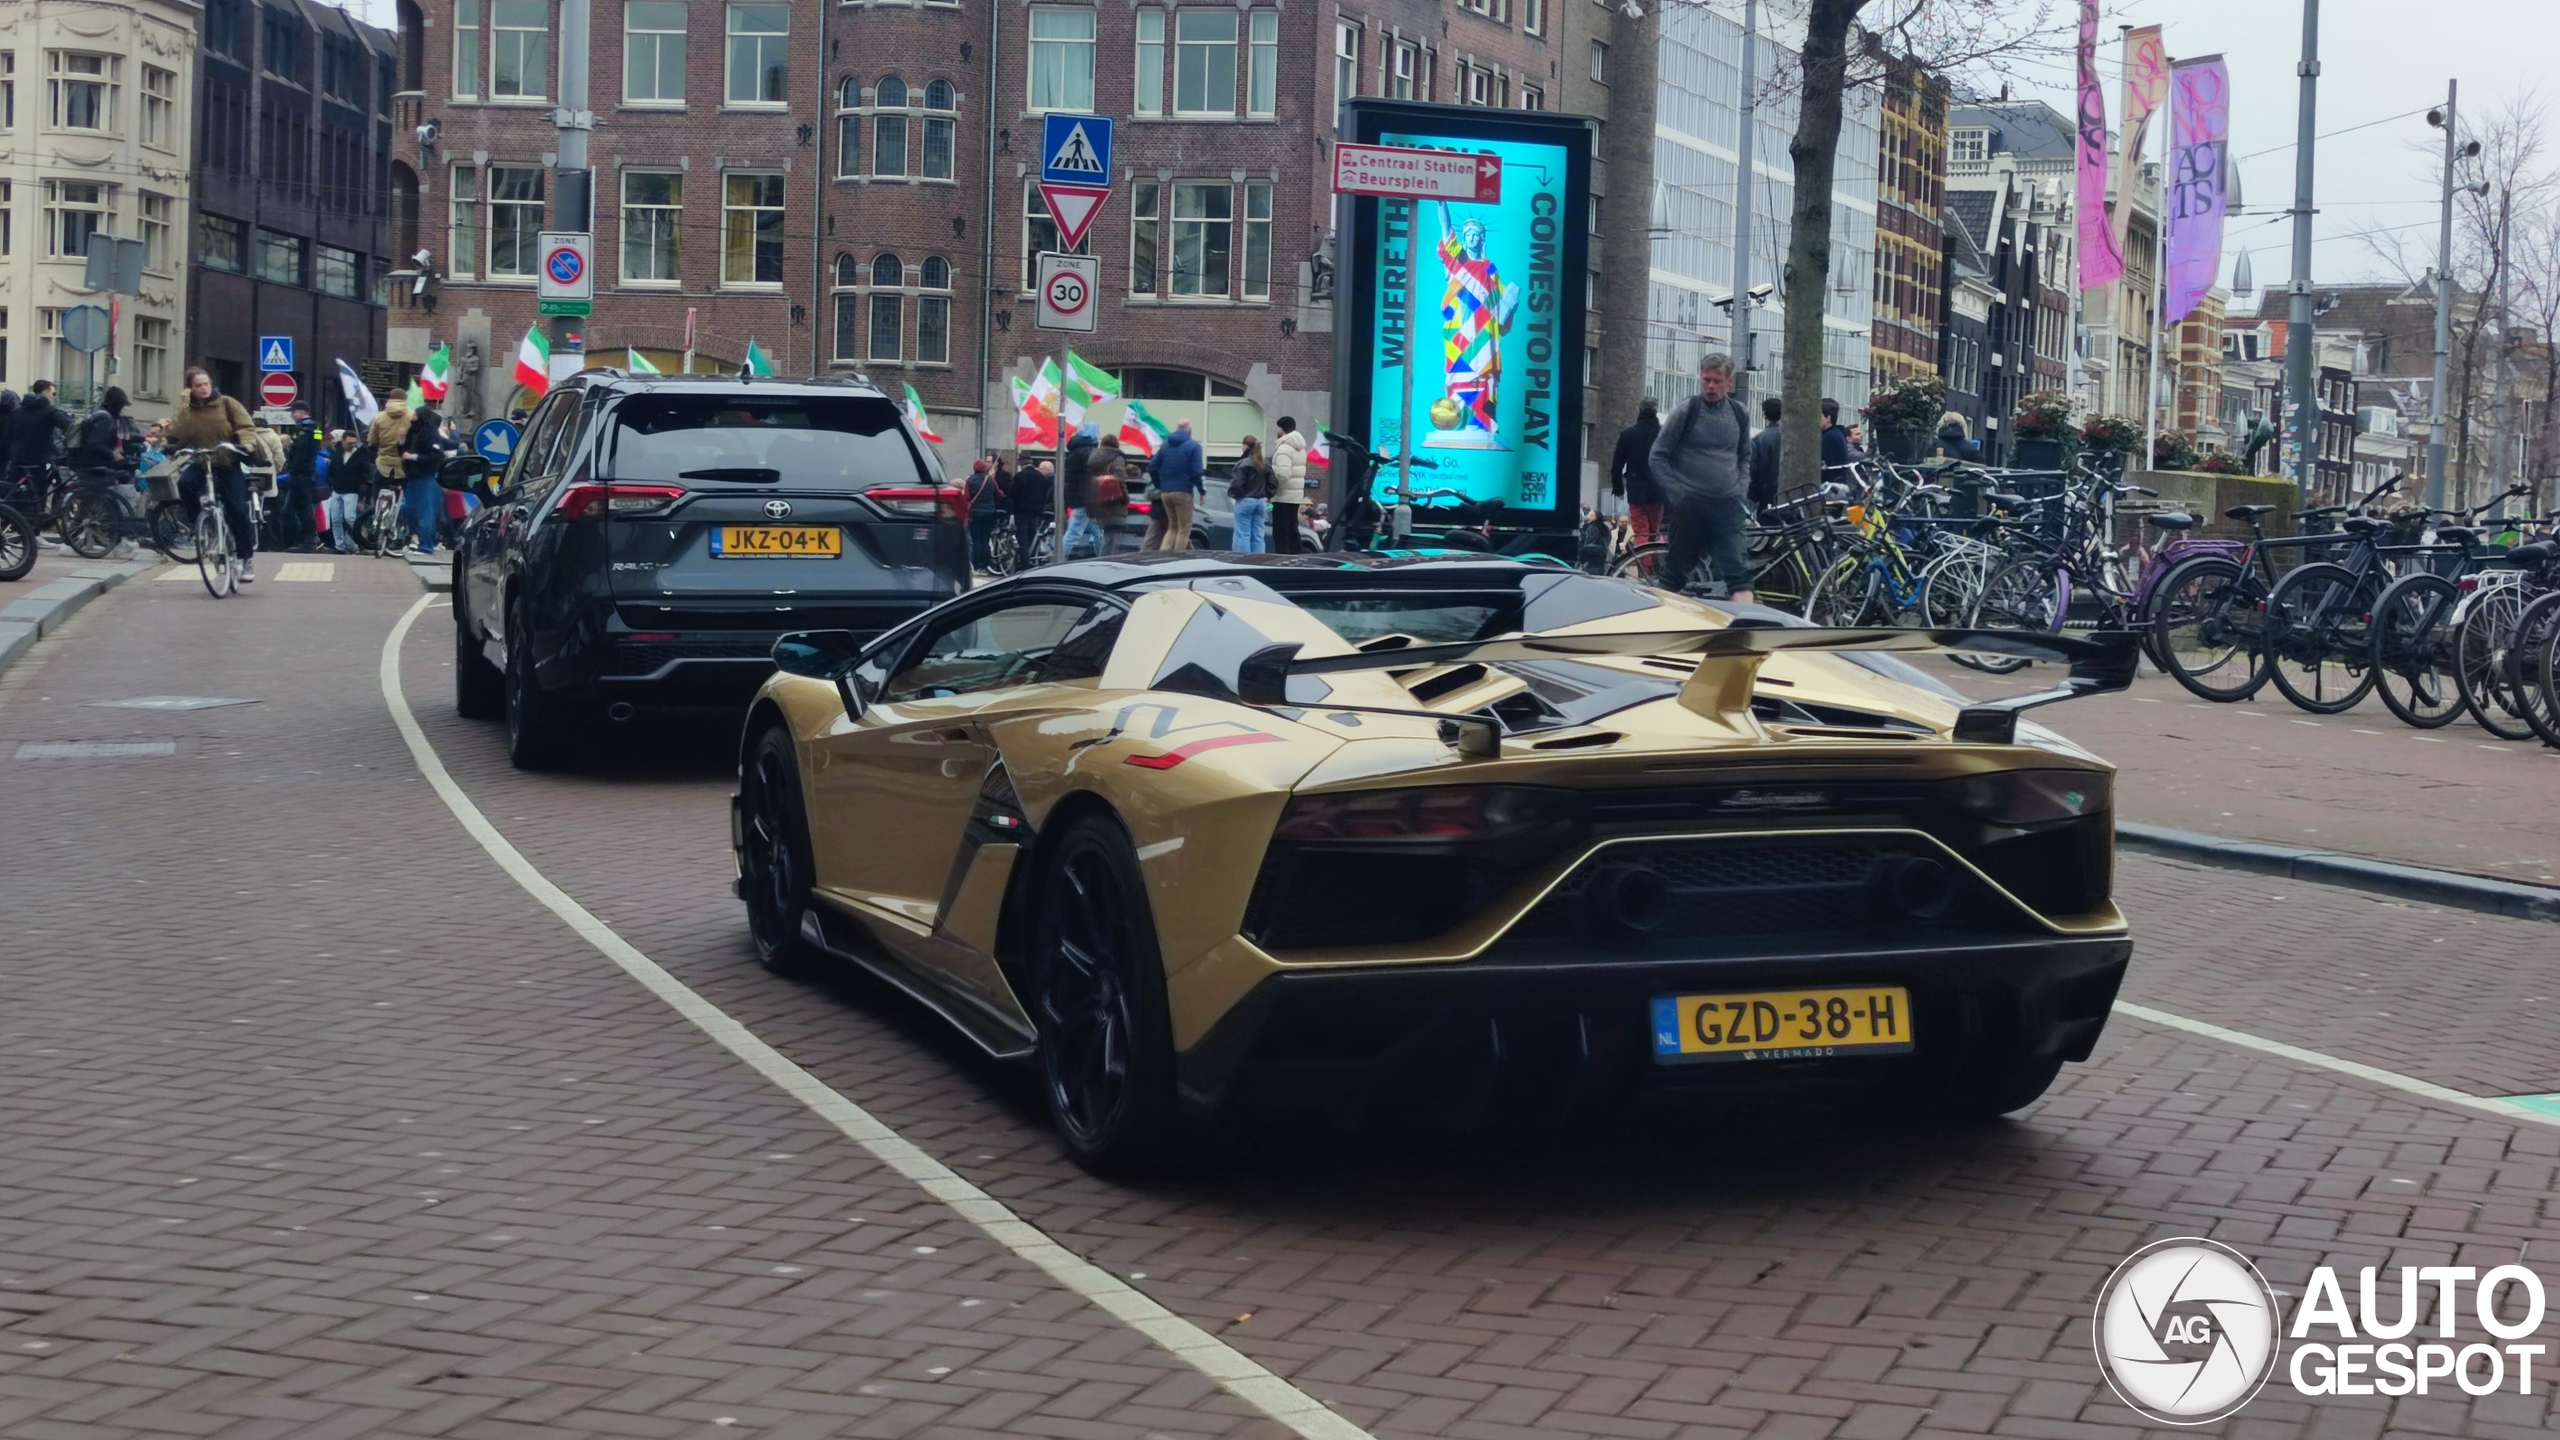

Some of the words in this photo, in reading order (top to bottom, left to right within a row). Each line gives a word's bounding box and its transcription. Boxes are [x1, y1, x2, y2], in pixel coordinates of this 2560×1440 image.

[1359, 154, 1419, 171] Centraal
[1423, 159, 1474, 175] Station
[1359, 171, 1439, 190] Beursplein
[1383, 197, 1410, 244] TH
[553, 237, 577, 245] ZONE
[1527, 192, 1557, 314] COMES
[1056, 260, 1082, 269] ZONE
[1054, 284, 1082, 302] 30
[1381, 248, 1407, 369] WHERE
[1525, 319, 1553, 363] TO
[1523, 368, 1552, 451] PLAY
[730, 530, 831, 550] JKZ-04-K
[1695, 995, 1896, 1045] GZD-38-H
[1658, 1032, 1677, 1046] NL
[1763, 1047, 1835, 1059] VERMADO
